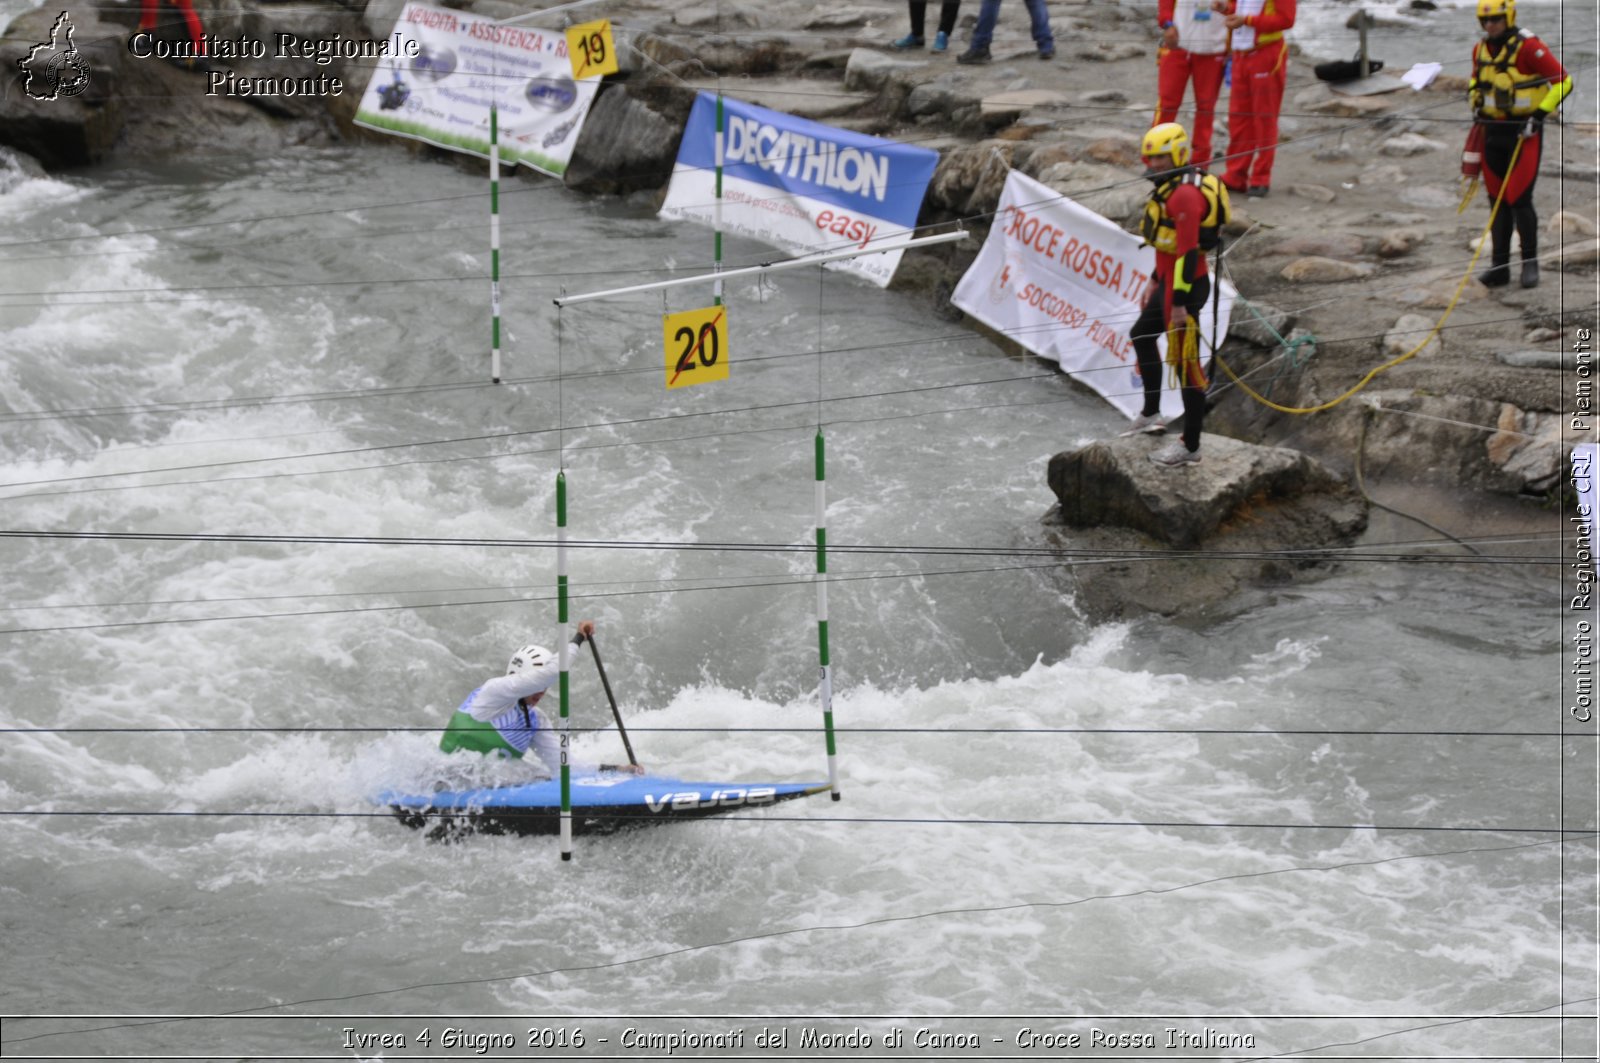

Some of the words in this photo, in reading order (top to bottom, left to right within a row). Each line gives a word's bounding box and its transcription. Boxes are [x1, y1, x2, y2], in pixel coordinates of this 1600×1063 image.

[406, 7, 458, 33] VENDITA
[468, 22, 544, 51] ASSISTENZA
[578, 34, 605, 66] 19
[726, 115, 889, 202] DECATHLON
[815, 209, 877, 250] easy
[1002, 205, 1064, 259] CROCE
[1060, 236, 1123, 293] ROSSA
[1017, 282, 1087, 329] SOCCORSO
[674, 322, 719, 373] 20
